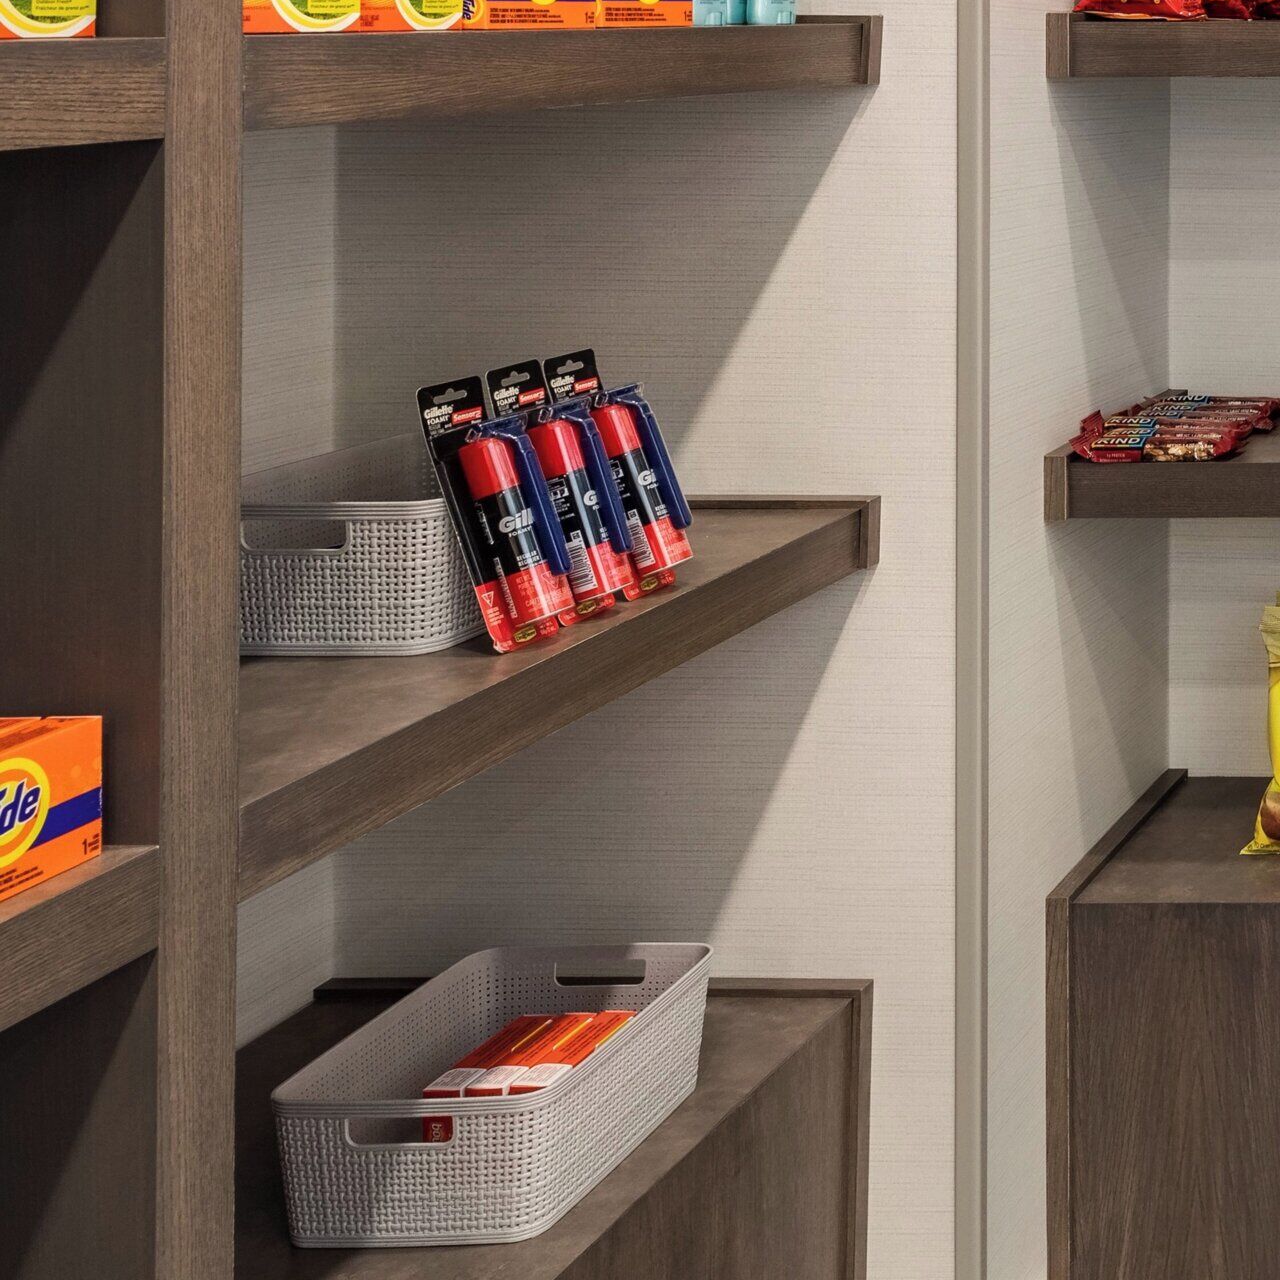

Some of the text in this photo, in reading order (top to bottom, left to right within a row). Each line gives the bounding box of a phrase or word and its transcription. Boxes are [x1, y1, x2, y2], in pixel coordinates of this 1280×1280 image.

[550, 376, 574, 389] Gillette
[493, 386, 520, 401] Gillette
[424, 404, 454, 419] Gillette
